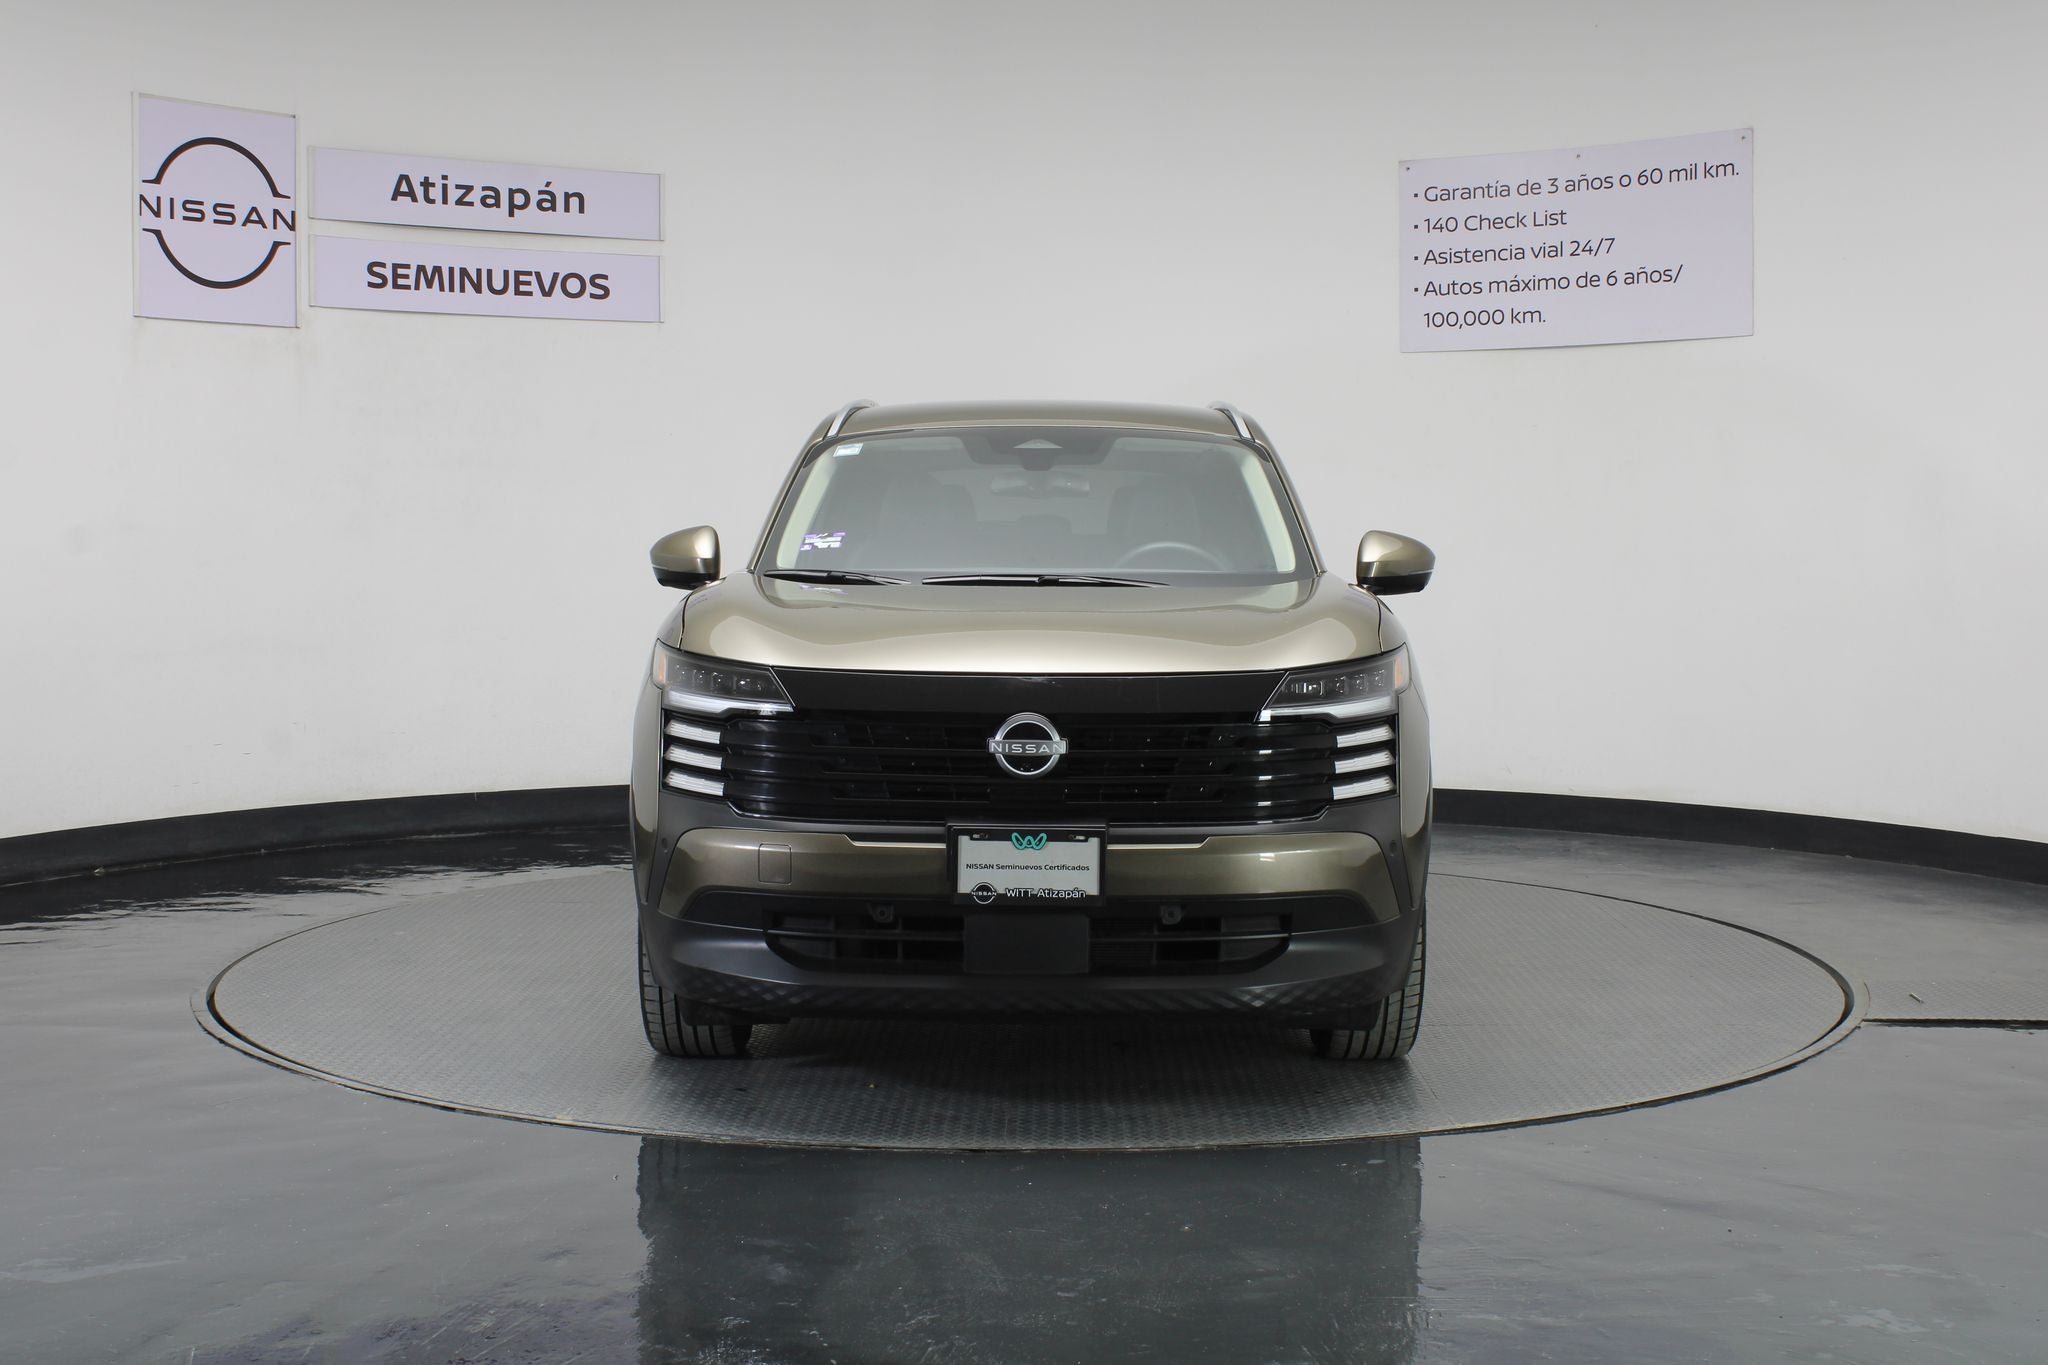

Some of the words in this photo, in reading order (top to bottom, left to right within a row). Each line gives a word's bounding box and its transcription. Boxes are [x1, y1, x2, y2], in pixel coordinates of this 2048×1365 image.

[391, 174, 584, 217] Atizapán
[1424, 180, 1510, 202] Garantía
[1517, 179, 1541, 196] de
[1548, 178, 1559, 194] 3
[1565, 174, 1613, 192] años
[1619, 174, 1631, 187] o
[1637, 168, 1663, 186] 60
[1669, 163, 1697, 183] mil
[1704, 162, 1739, 179] km.
[139, 193, 296, 232] NISSAN
[1424, 217, 1458, 233] 140
[1464, 212, 1527, 231] Check
[1533, 210, 1567, 227] List
[1424, 244, 1525, 265] Asistencia
[1530, 241, 1563, 259] vial
[1570, 238, 1615, 256] 24/7
[367, 261, 610, 299] SEMINUEVOS
[1424, 280, 1482, 296] Autos
[1489, 275, 1570, 293] máximo
[1576, 272, 1600, 288] de
[1606, 270, 1617, 286] 6
[1624, 264, 1683, 285] años/
[1424, 309, 1504, 329] 100,000
[1511, 308, 1546, 324] km.
[991, 742, 1064, 754] NISSAN
[996, 863, 1043, 871] Seminuevos
[1044, 864, 1090, 872] Certificados
[1037, 886, 1087, 899] Atizapán
